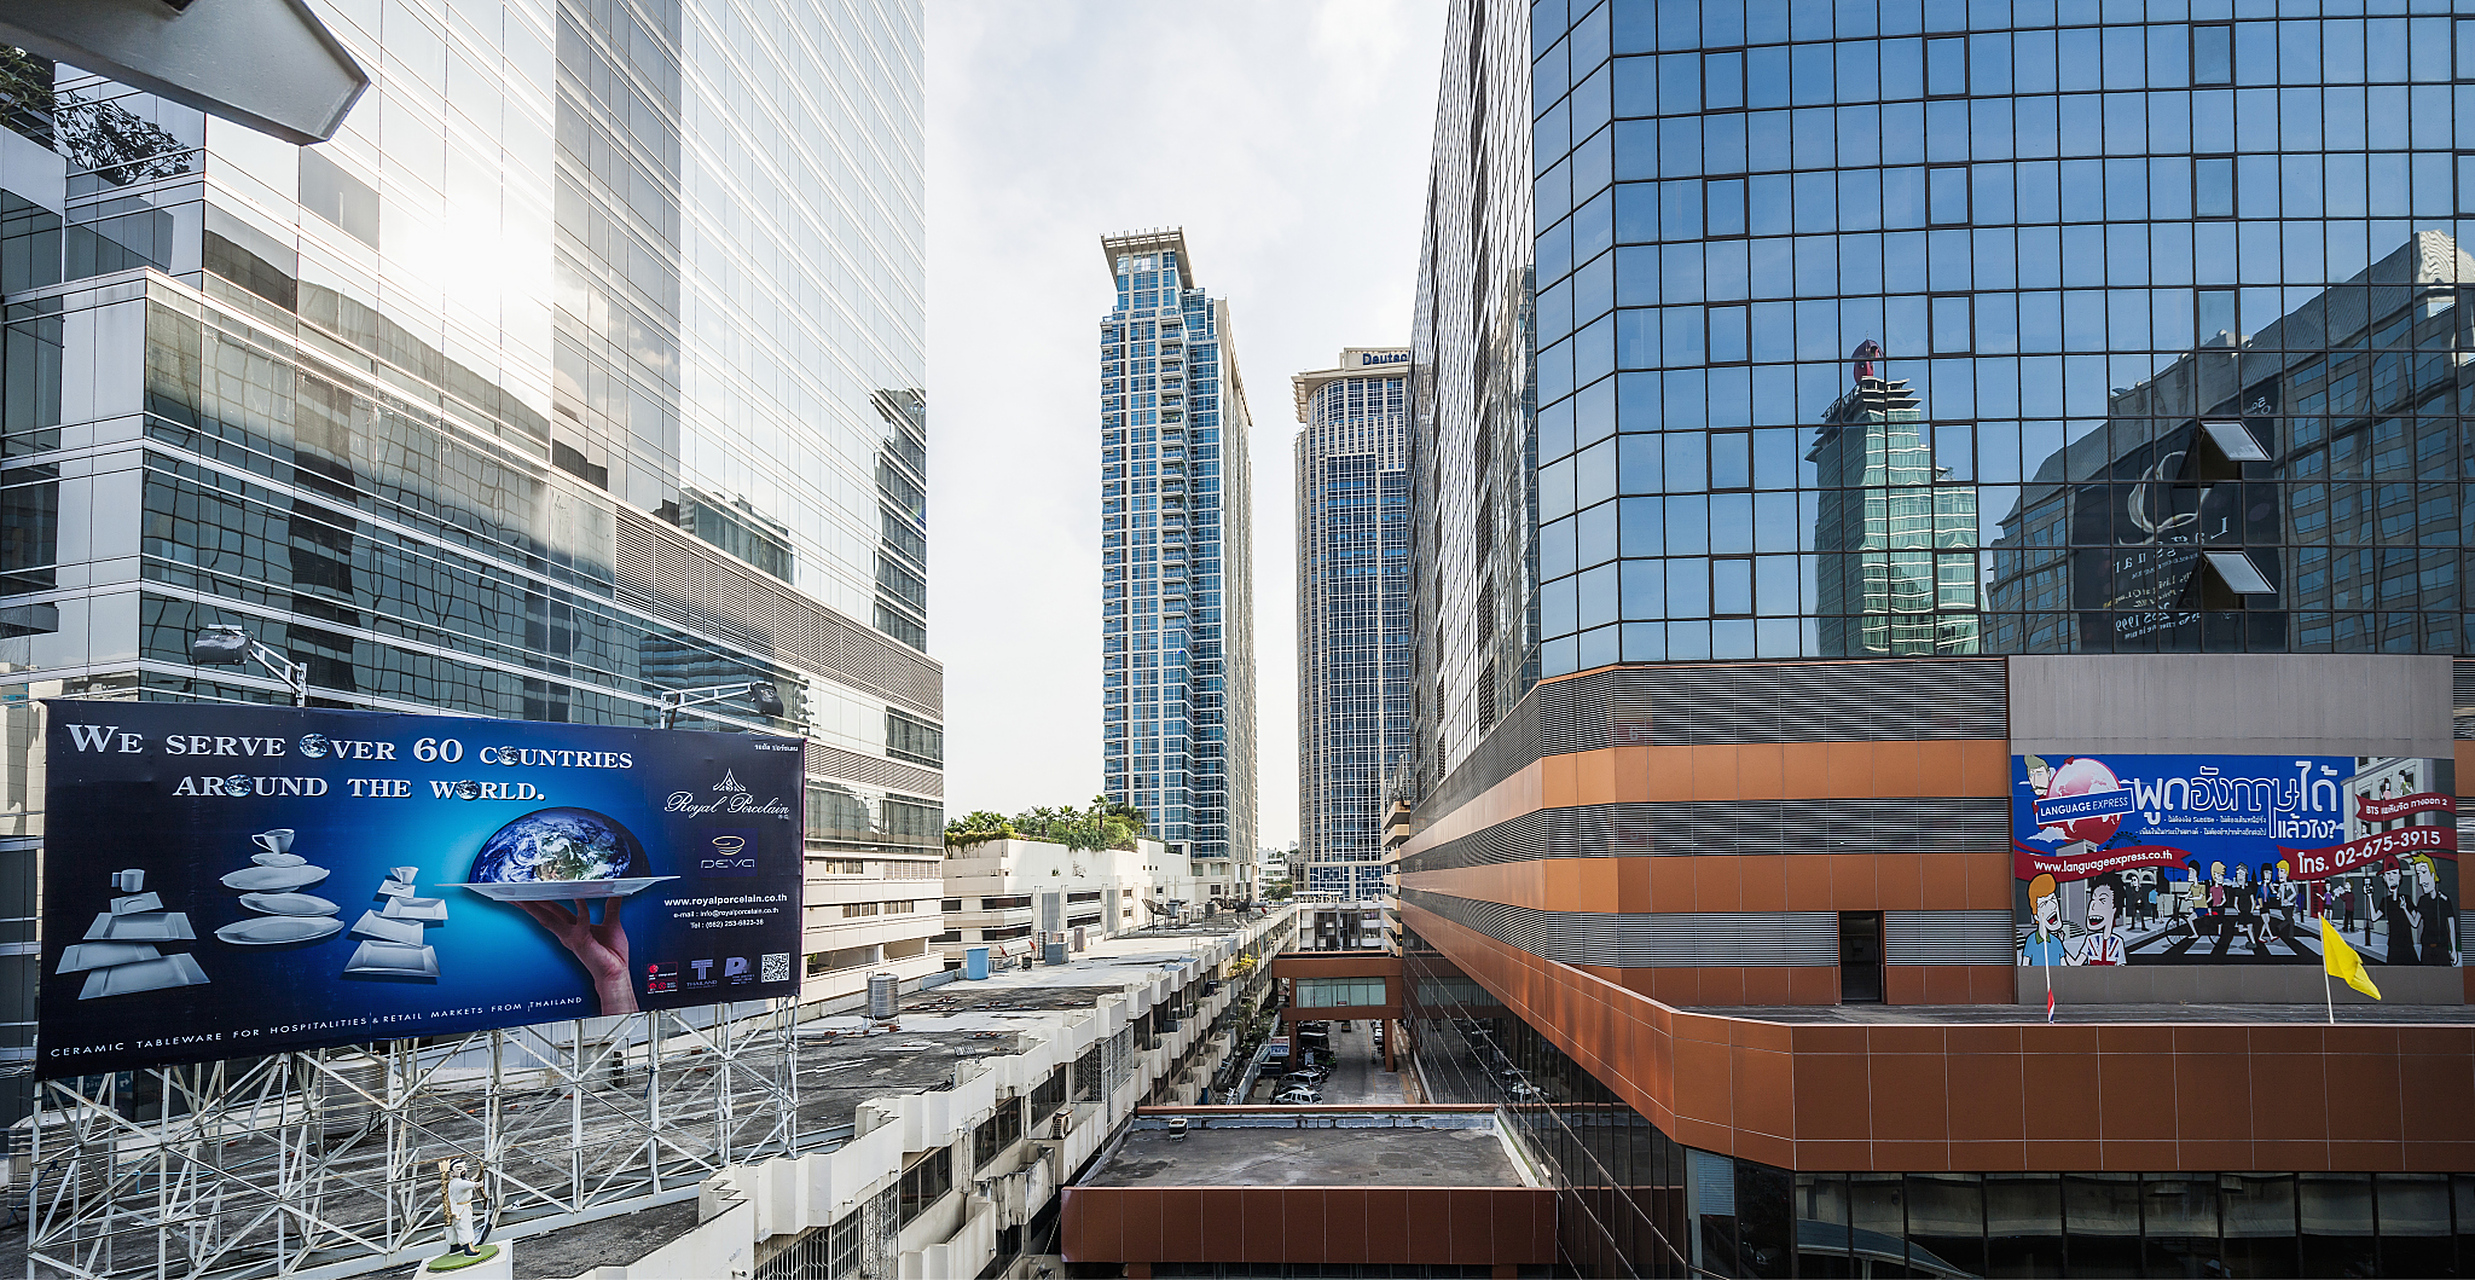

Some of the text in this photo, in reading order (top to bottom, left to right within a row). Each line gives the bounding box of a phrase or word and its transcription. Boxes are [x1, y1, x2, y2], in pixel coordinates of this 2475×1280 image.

[165, 734, 286, 757] SERVE
[413, 737, 465, 763] 60
[480, 745, 634, 769] COUNTRIES
[172, 773, 546, 801] AROUND THE WORLD.
[664, 791, 790, 819] Royal Porcelain
[2040, 796, 2128, 817] LANGUAGE EXPRESS
[2366, 805, 2379, 815] BTS
[2411, 798, 2441, 808] ทางออก
[2442, 798, 2448, 806] 2
[2278, 813, 2336, 839] แล้วไง?
[2297, 830, 2441, 874] โทร. 02-675-3915
[664, 893, 788, 907] www.royalporcelain.co.th
[50, 1042, 125, 1058] CERAMIC
[136, 1032, 223, 1049] TABLEWARE
[232, 1028, 260, 1039] FOR
[269, 1017, 367, 1035] HOSPITALITIES
[383, 1012, 422, 1023] RETAIL
[430, 1006, 484, 1019] MARKETS
[491, 1002, 522, 1014] FROM
[529, 996, 583, 1009] THAILAND
